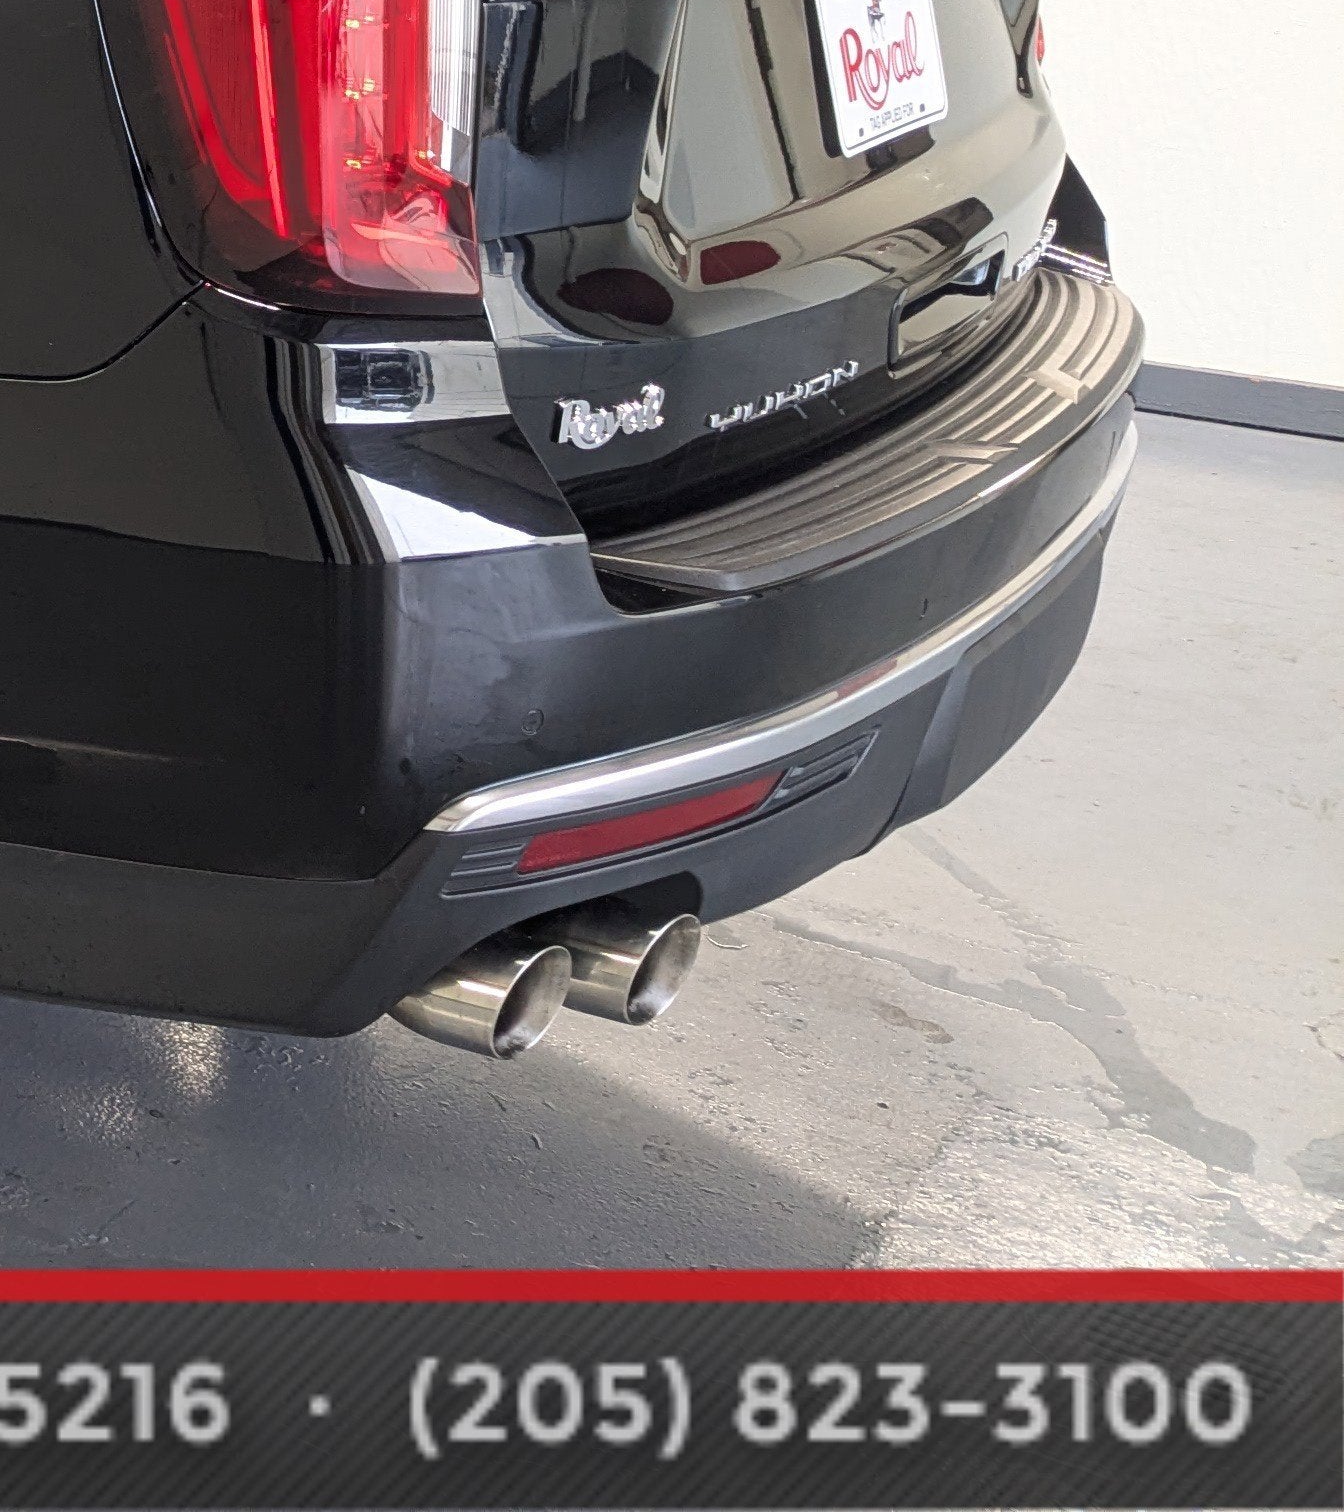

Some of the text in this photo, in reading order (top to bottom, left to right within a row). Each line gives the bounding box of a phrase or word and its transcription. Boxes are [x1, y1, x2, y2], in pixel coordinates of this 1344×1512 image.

[838, 11, 924, 110] Royal
[558, 384, 666, 450] Royal
[709, 360, 860, 433] YUKON
